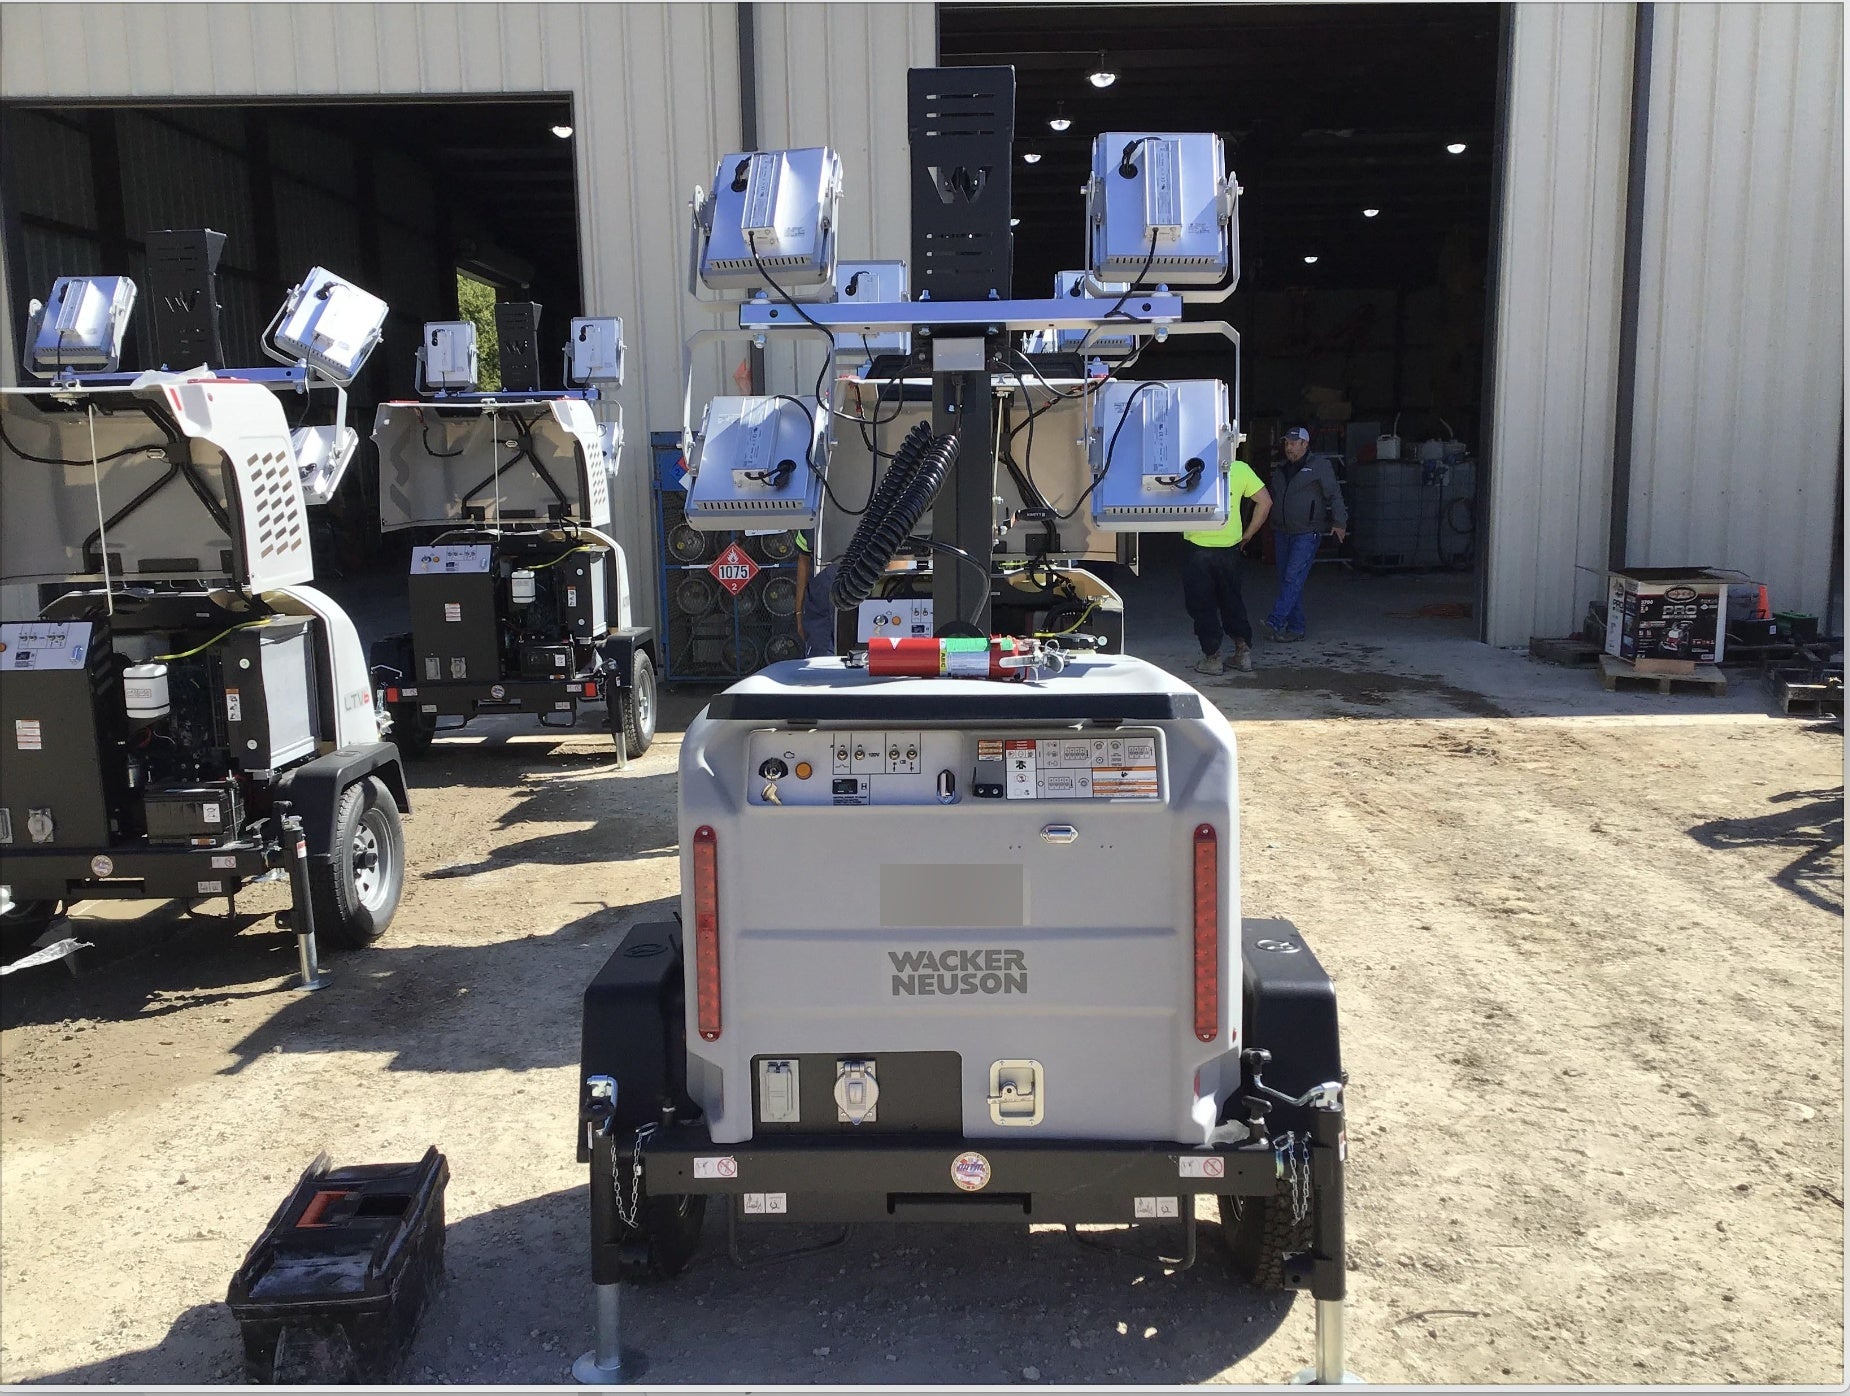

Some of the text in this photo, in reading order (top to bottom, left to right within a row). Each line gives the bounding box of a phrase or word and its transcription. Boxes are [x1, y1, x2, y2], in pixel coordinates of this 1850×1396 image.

[719, 565, 749, 579] 1075
[731, 582, 738, 591] 2
[1662, 605, 1698, 615] PRO
[888, 949, 1028, 973] WACKER
[892, 972, 1028, 996] NEUSON
